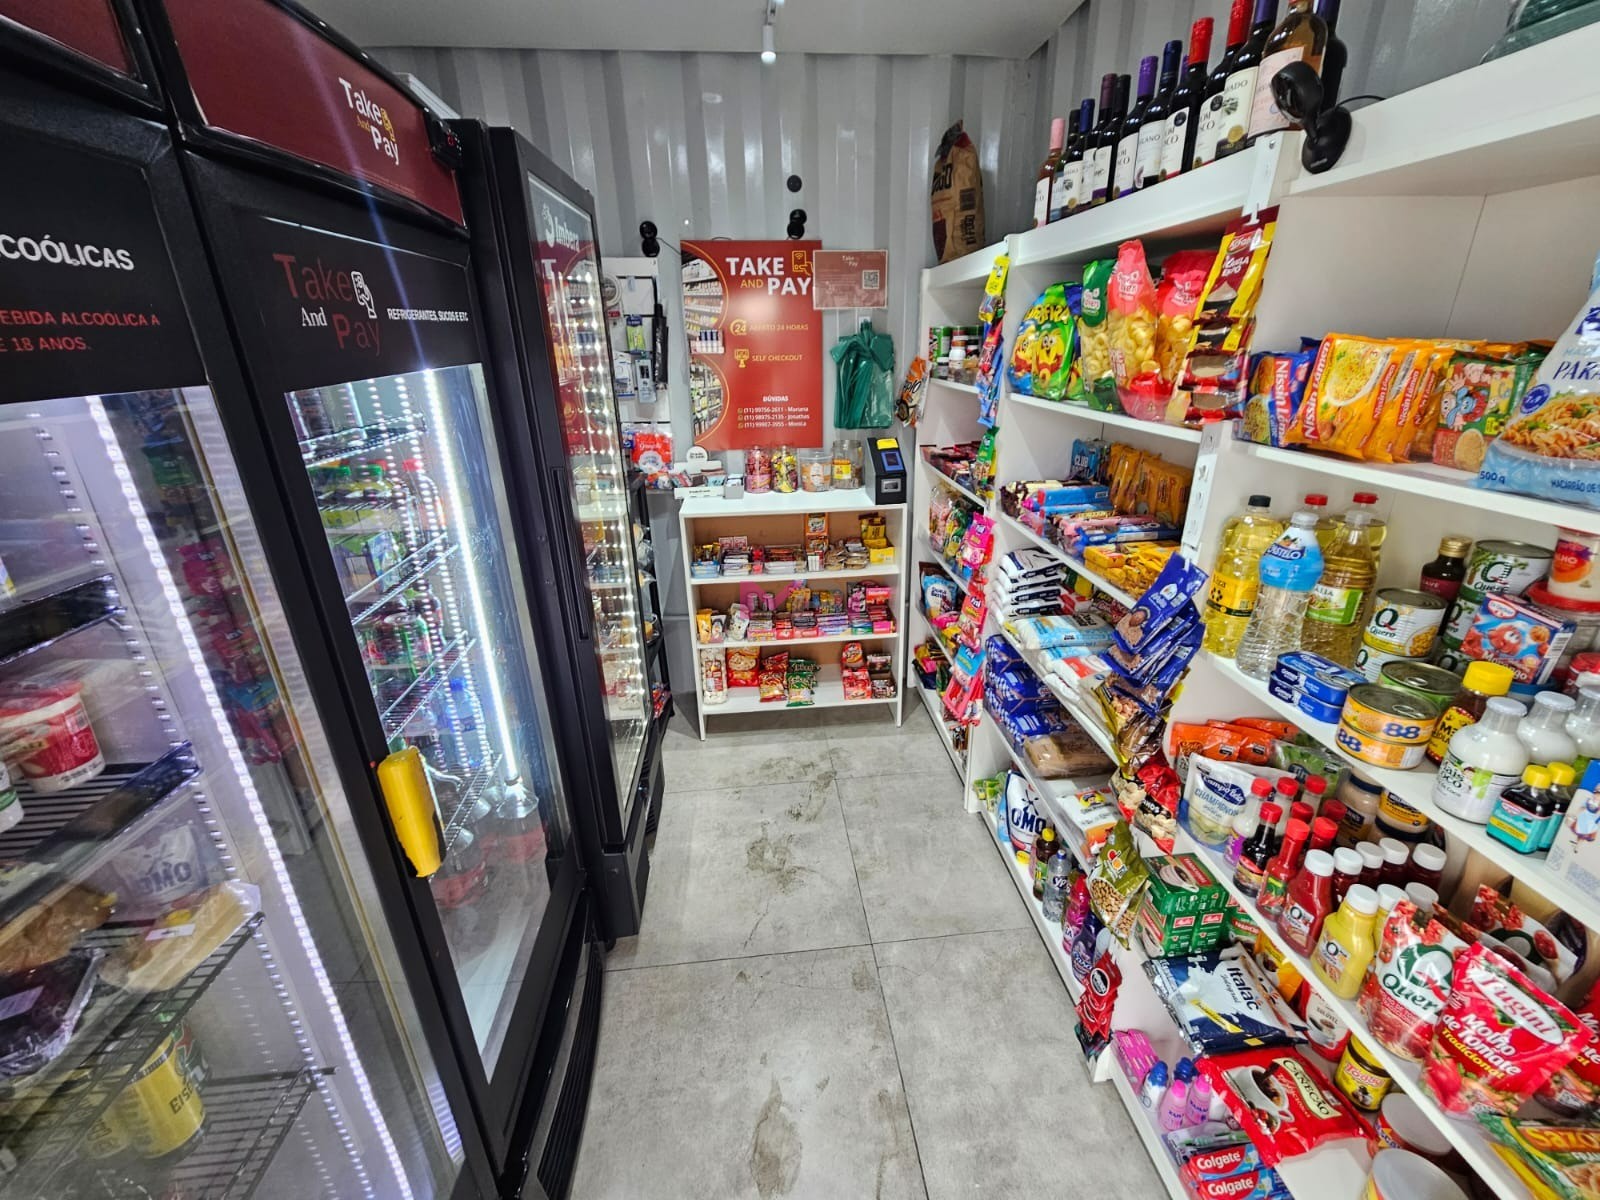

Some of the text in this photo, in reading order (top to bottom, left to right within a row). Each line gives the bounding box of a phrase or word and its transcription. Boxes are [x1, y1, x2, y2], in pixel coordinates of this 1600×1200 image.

[338, 77, 382, 125] Take
[370, 125, 399, 165] Pay
[273, 253, 354, 301] Take
[725, 256, 785, 276] TAKE
[740, 279, 764, 289] AND
[767, 276, 811, 296] PAY
[151, 314, 161, 326] A
[301, 307, 327, 327] And
[786, 323, 809, 331] HORAS
[12, 337, 34, 351] 18
[39, 337, 92, 351] ANOS.
[332, 313, 382, 357] Pay
[1275, 360, 1291, 406] Nissin
[1303, 391, 1319, 440] Nissin
[1480, 470, 1498, 482] 500
[1551, 480, 1586, 493] MACARRÃO
[1374, 607, 1400, 631] Q
[1368, 624, 1398, 639] Quero
[1354, 648, 1370, 672] Q
[1337, 728, 1362, 753] 88
[1383, 723, 1422, 740] 88
[1203, 776, 1229, 794] Campo
[1010, 807, 1047, 835] OMO
[1227, 967, 1259, 1011] Italac
[1442, 1013, 1522, 1077] de Tomate
[1461, 1013, 1517, 1057] Molho
[1441, 1028, 1507, 1080] Tradicional
[1282, 1059, 1331, 1116] CANECÃO
[1197, 1151, 1242, 1170] Colgate
[1208, 1179, 1255, 1197] Colgate
